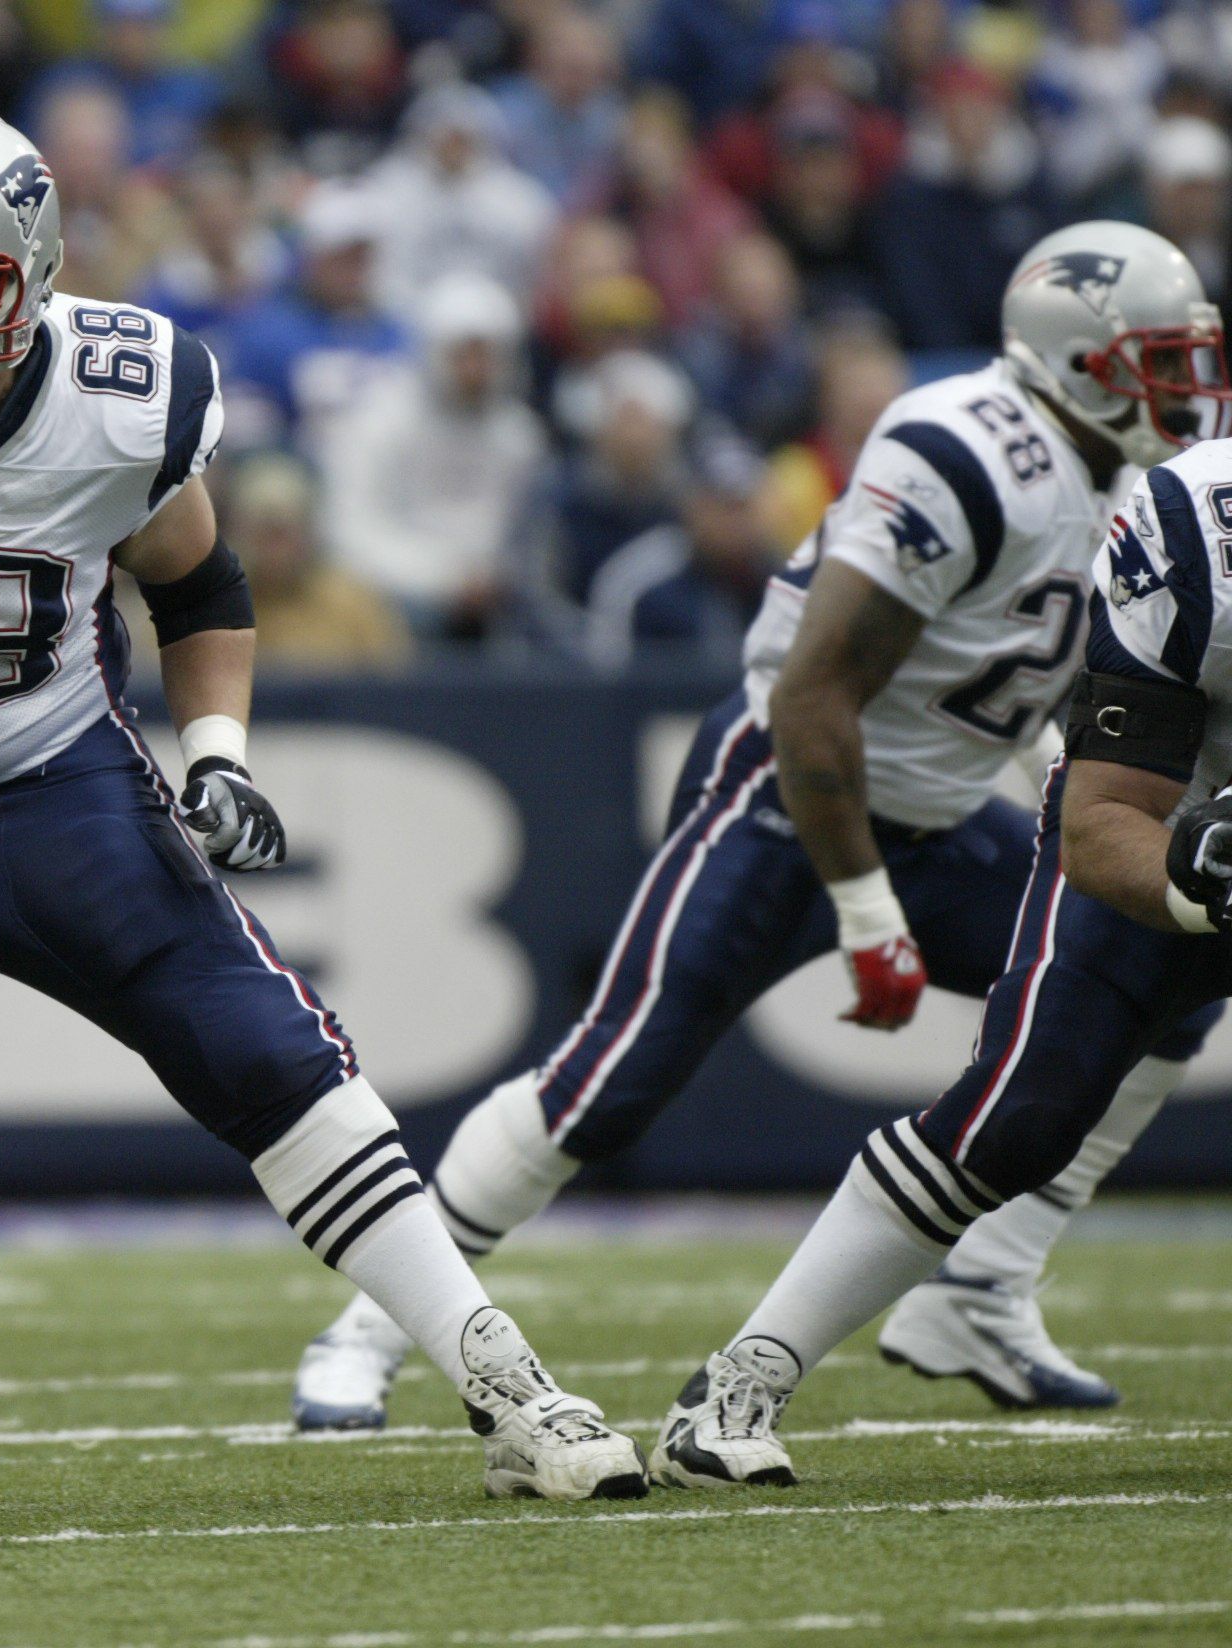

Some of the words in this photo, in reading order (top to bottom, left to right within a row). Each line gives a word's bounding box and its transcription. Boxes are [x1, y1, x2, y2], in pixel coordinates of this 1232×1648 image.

[68, 304, 159, 404] 68
[963, 390, 1056, 491] 28
[926, 569, 1090, 746] 2
